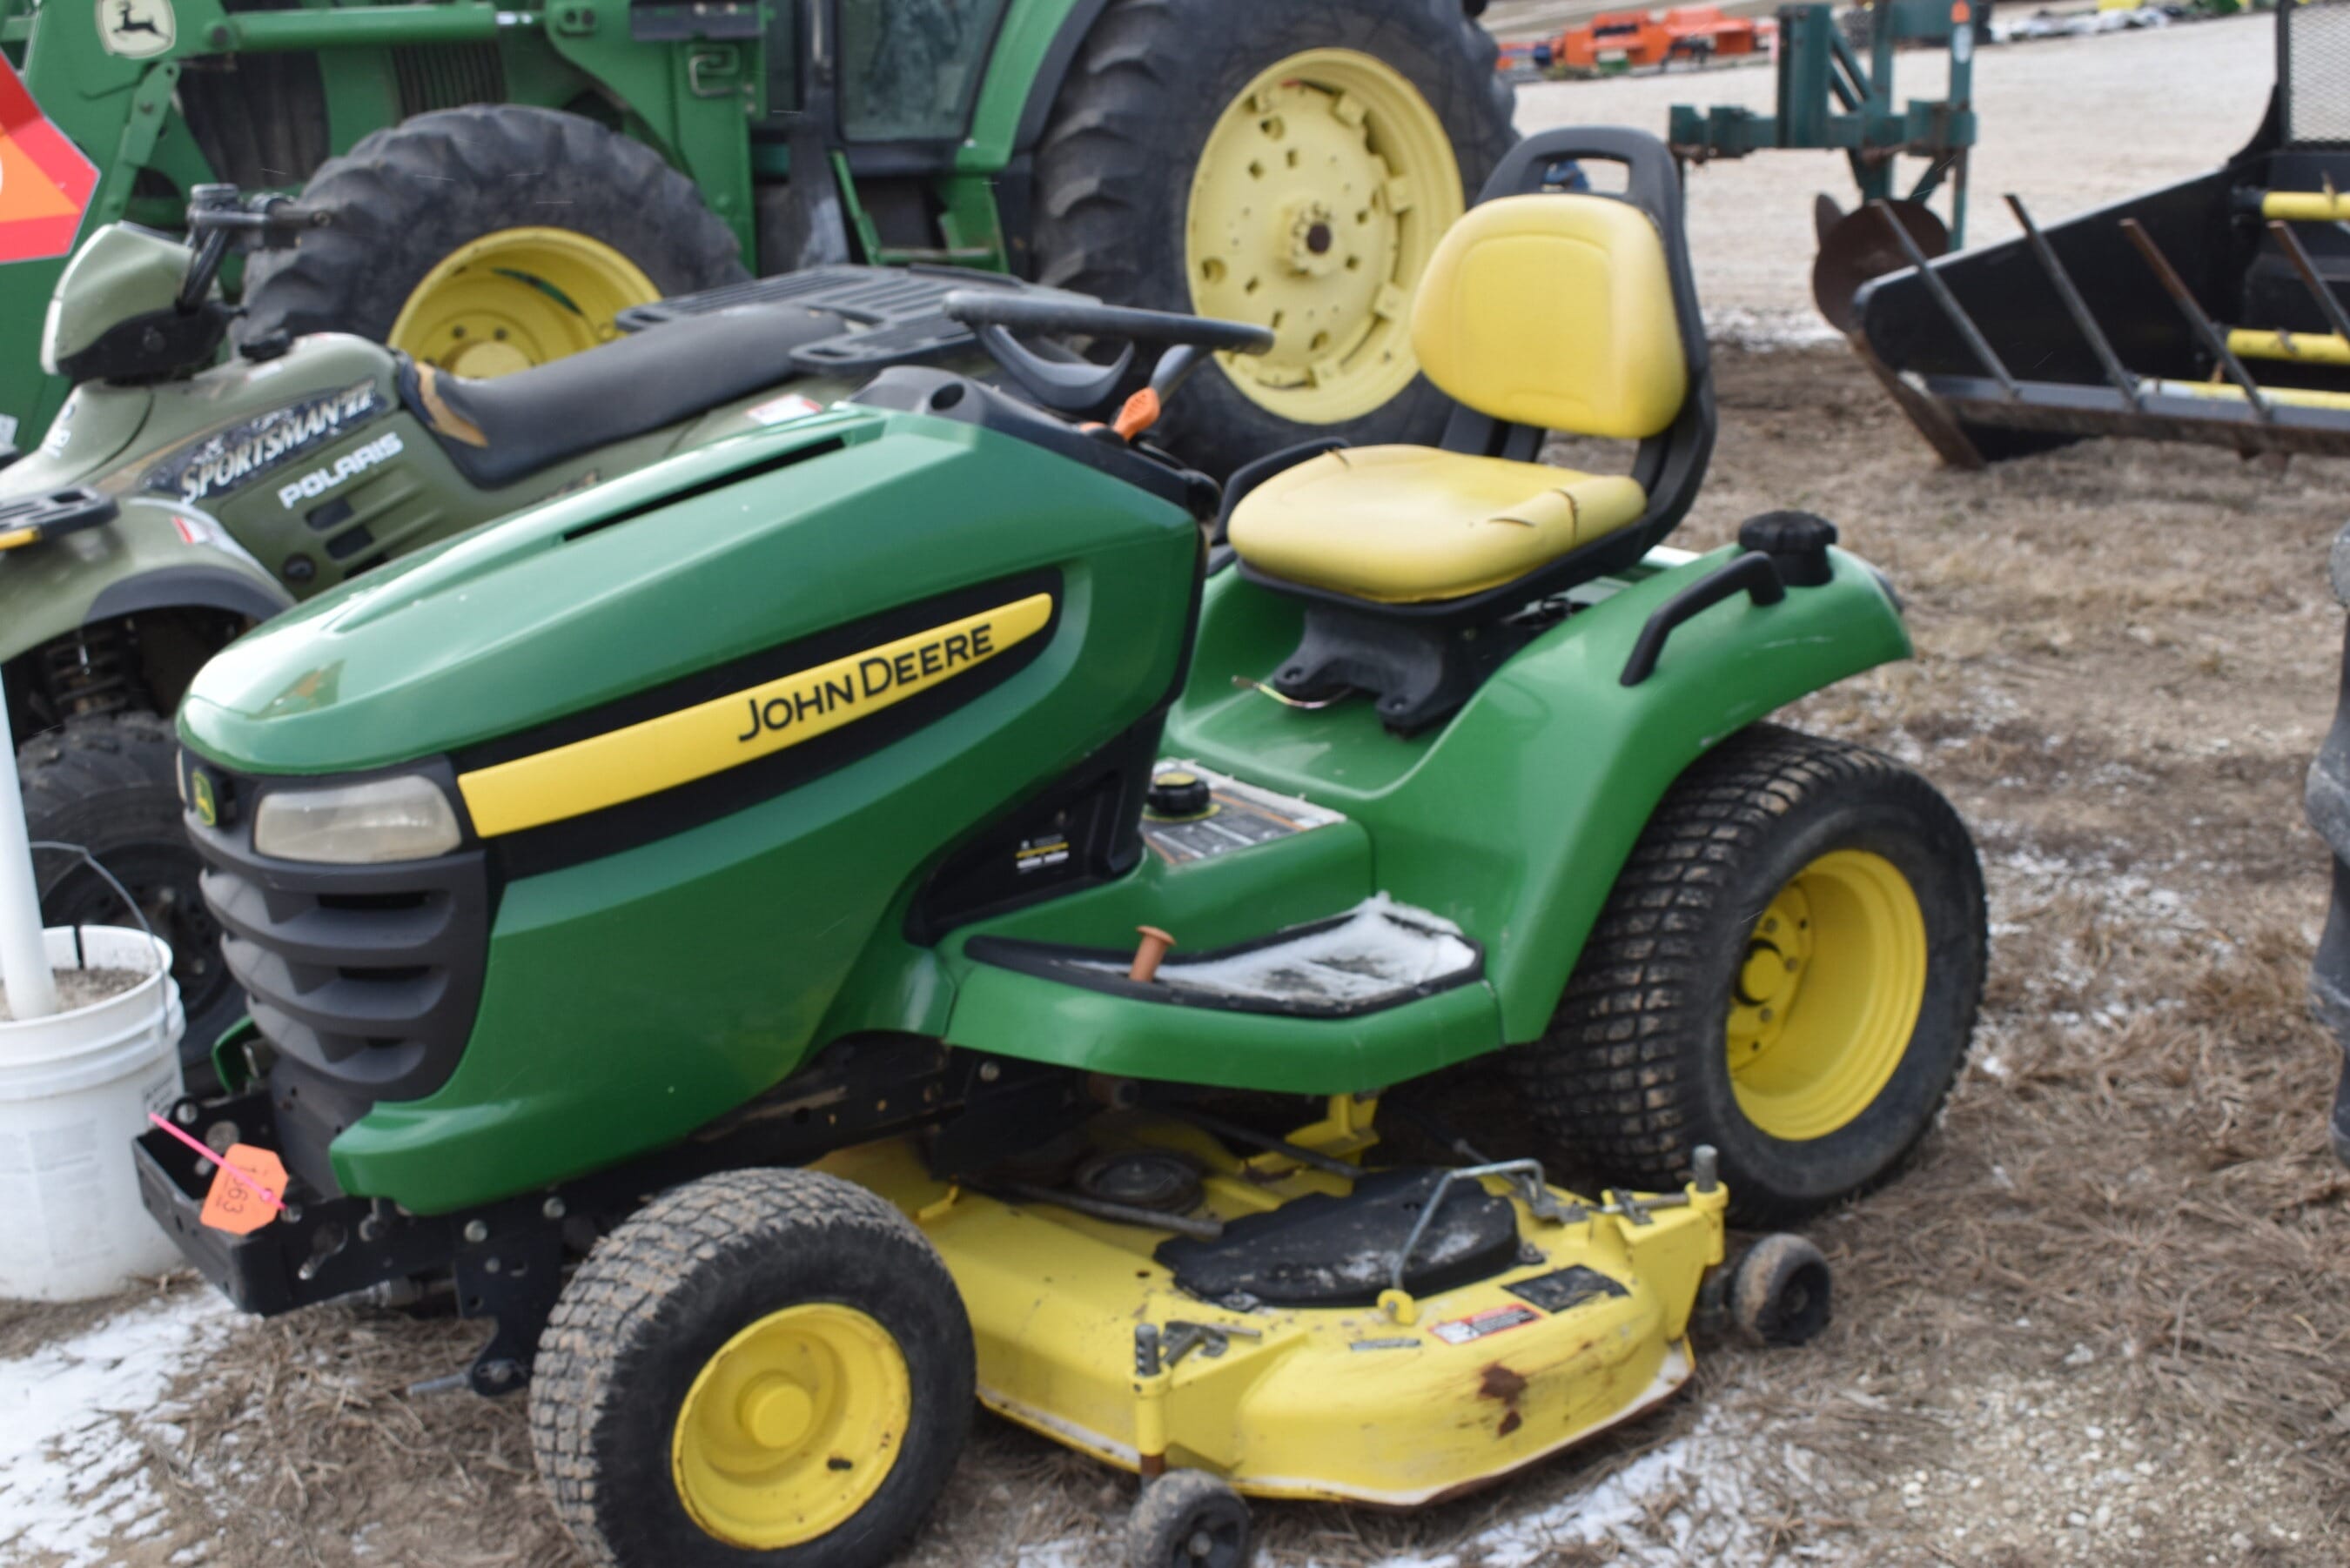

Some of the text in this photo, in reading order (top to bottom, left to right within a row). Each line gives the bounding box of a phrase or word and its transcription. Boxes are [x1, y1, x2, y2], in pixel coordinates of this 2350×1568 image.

[180, 397, 340, 506] SPORTSMAN
[277, 431, 404, 509] POLARIS
[738, 623, 995, 742] JOHN DEERE
